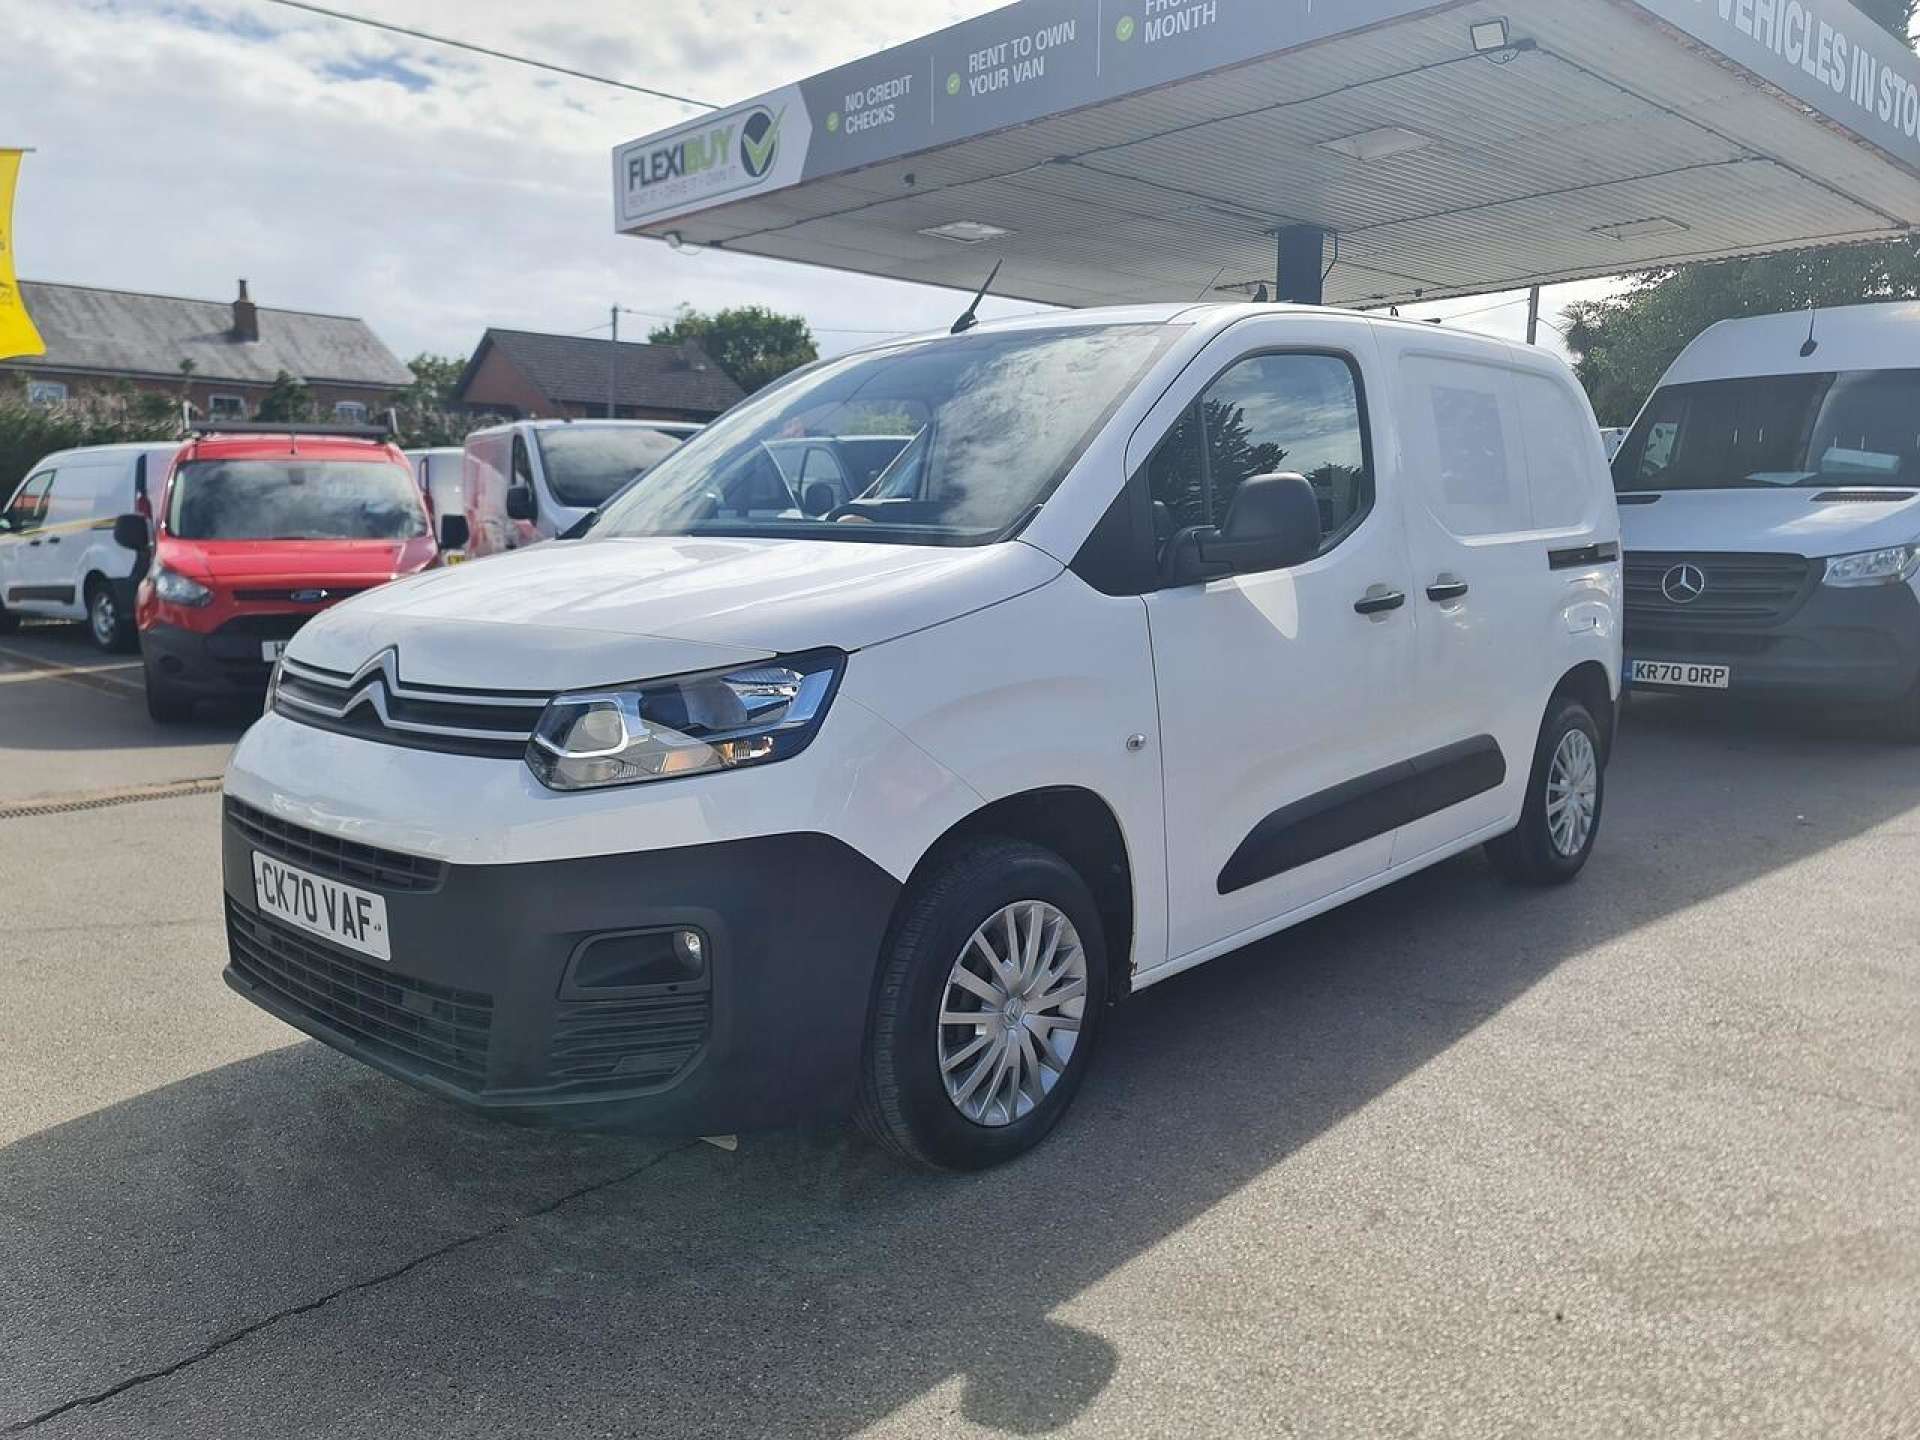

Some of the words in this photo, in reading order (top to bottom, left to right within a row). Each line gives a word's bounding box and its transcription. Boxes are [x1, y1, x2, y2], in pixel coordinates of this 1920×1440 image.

[1145, 0, 1191, 16] FR
[1145, 0, 1216, 44] MONTH
[968, 42, 1009, 73] RENT
[1011, 36, 1032, 59] TO
[1035, 20, 1076, 50] OWN
[845, 91, 865, 112] NO
[866, 74, 913, 106] CREDIT
[968, 68, 1009, 97] YOUR
[1012, 56, 1045, 84] VAN
[1850, 45, 1876, 112] IN
[1878, 66, 1920, 143] STO
[845, 104, 896, 134] CHECKS
[629, 124, 736, 192] FLEXIBUY
[1635, 663, 1682, 682] KR70
[1688, 667, 1725, 685] ORP
[262, 861, 318, 923] CK70
[321, 884, 373, 942] VAF
